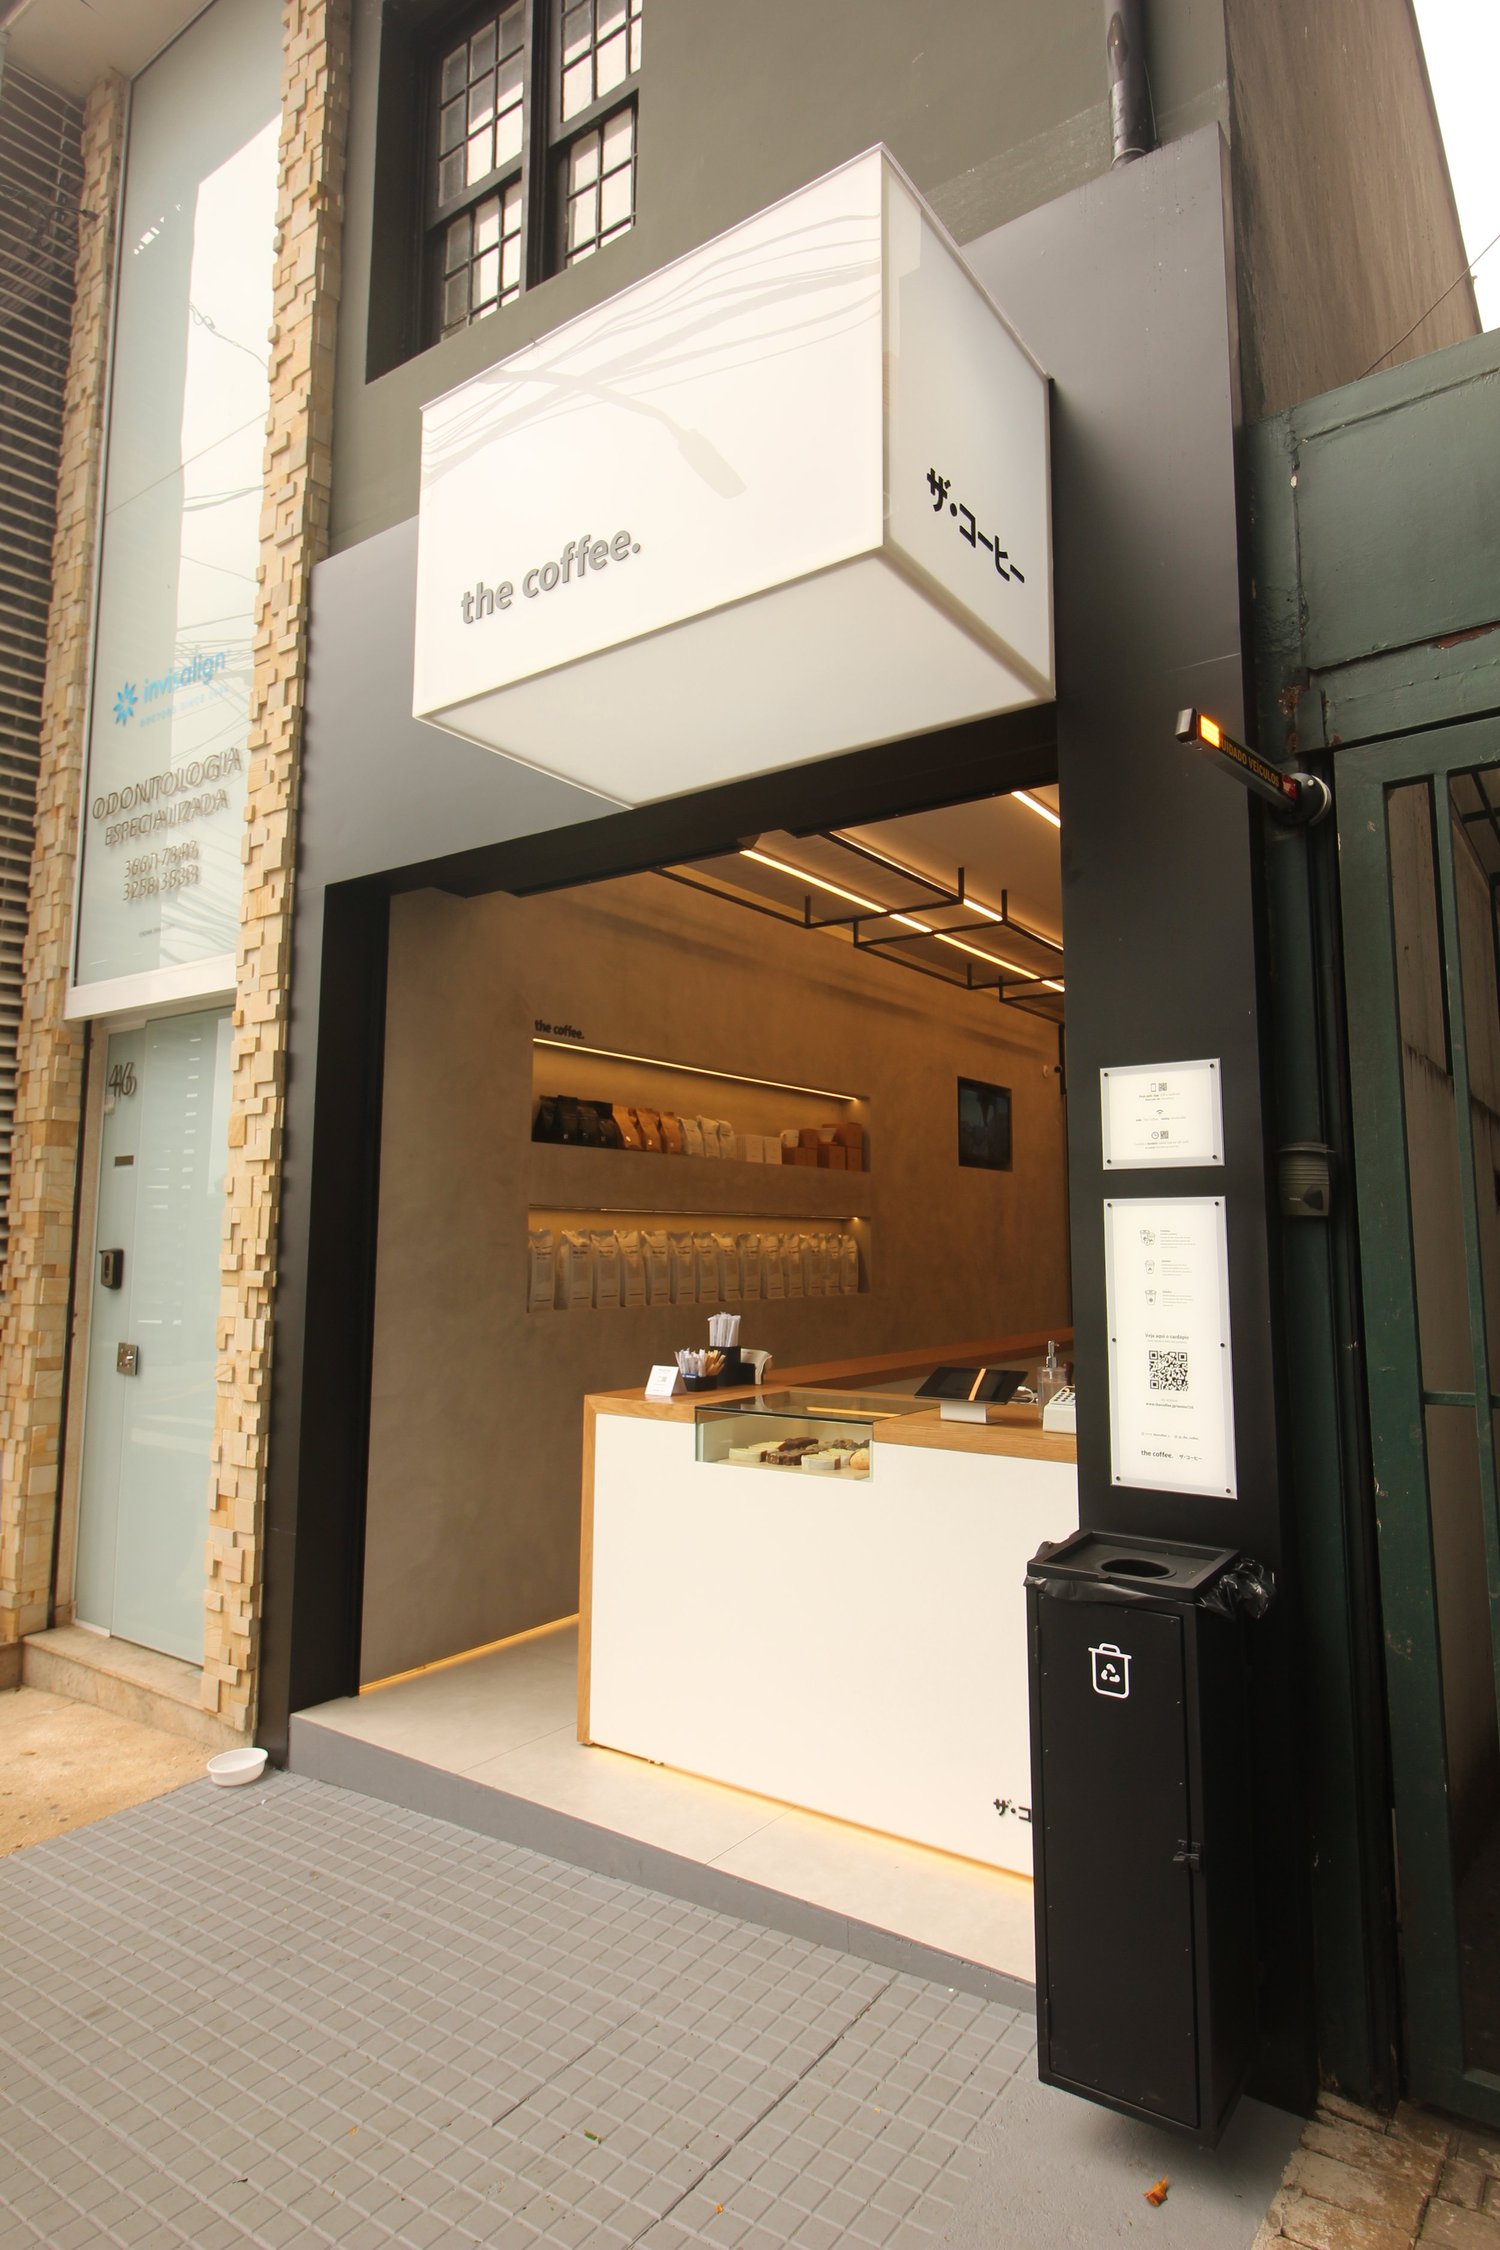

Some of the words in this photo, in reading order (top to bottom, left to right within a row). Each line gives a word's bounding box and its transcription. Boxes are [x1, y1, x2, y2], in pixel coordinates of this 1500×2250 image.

[926, 467, 1025, 584] ザ・コーヒー
[460, 580, 514, 625] the
[522, 530, 641, 599] coffee.
[1220, 739, 1247, 765] UIDADO
[93, 747, 242, 821] ODONTOLOGIA
[105, 788, 230, 847] ESPECIALIZADA
[534, 1019, 551, 1033] the
[1141, 1449, 1152, 1457] the
